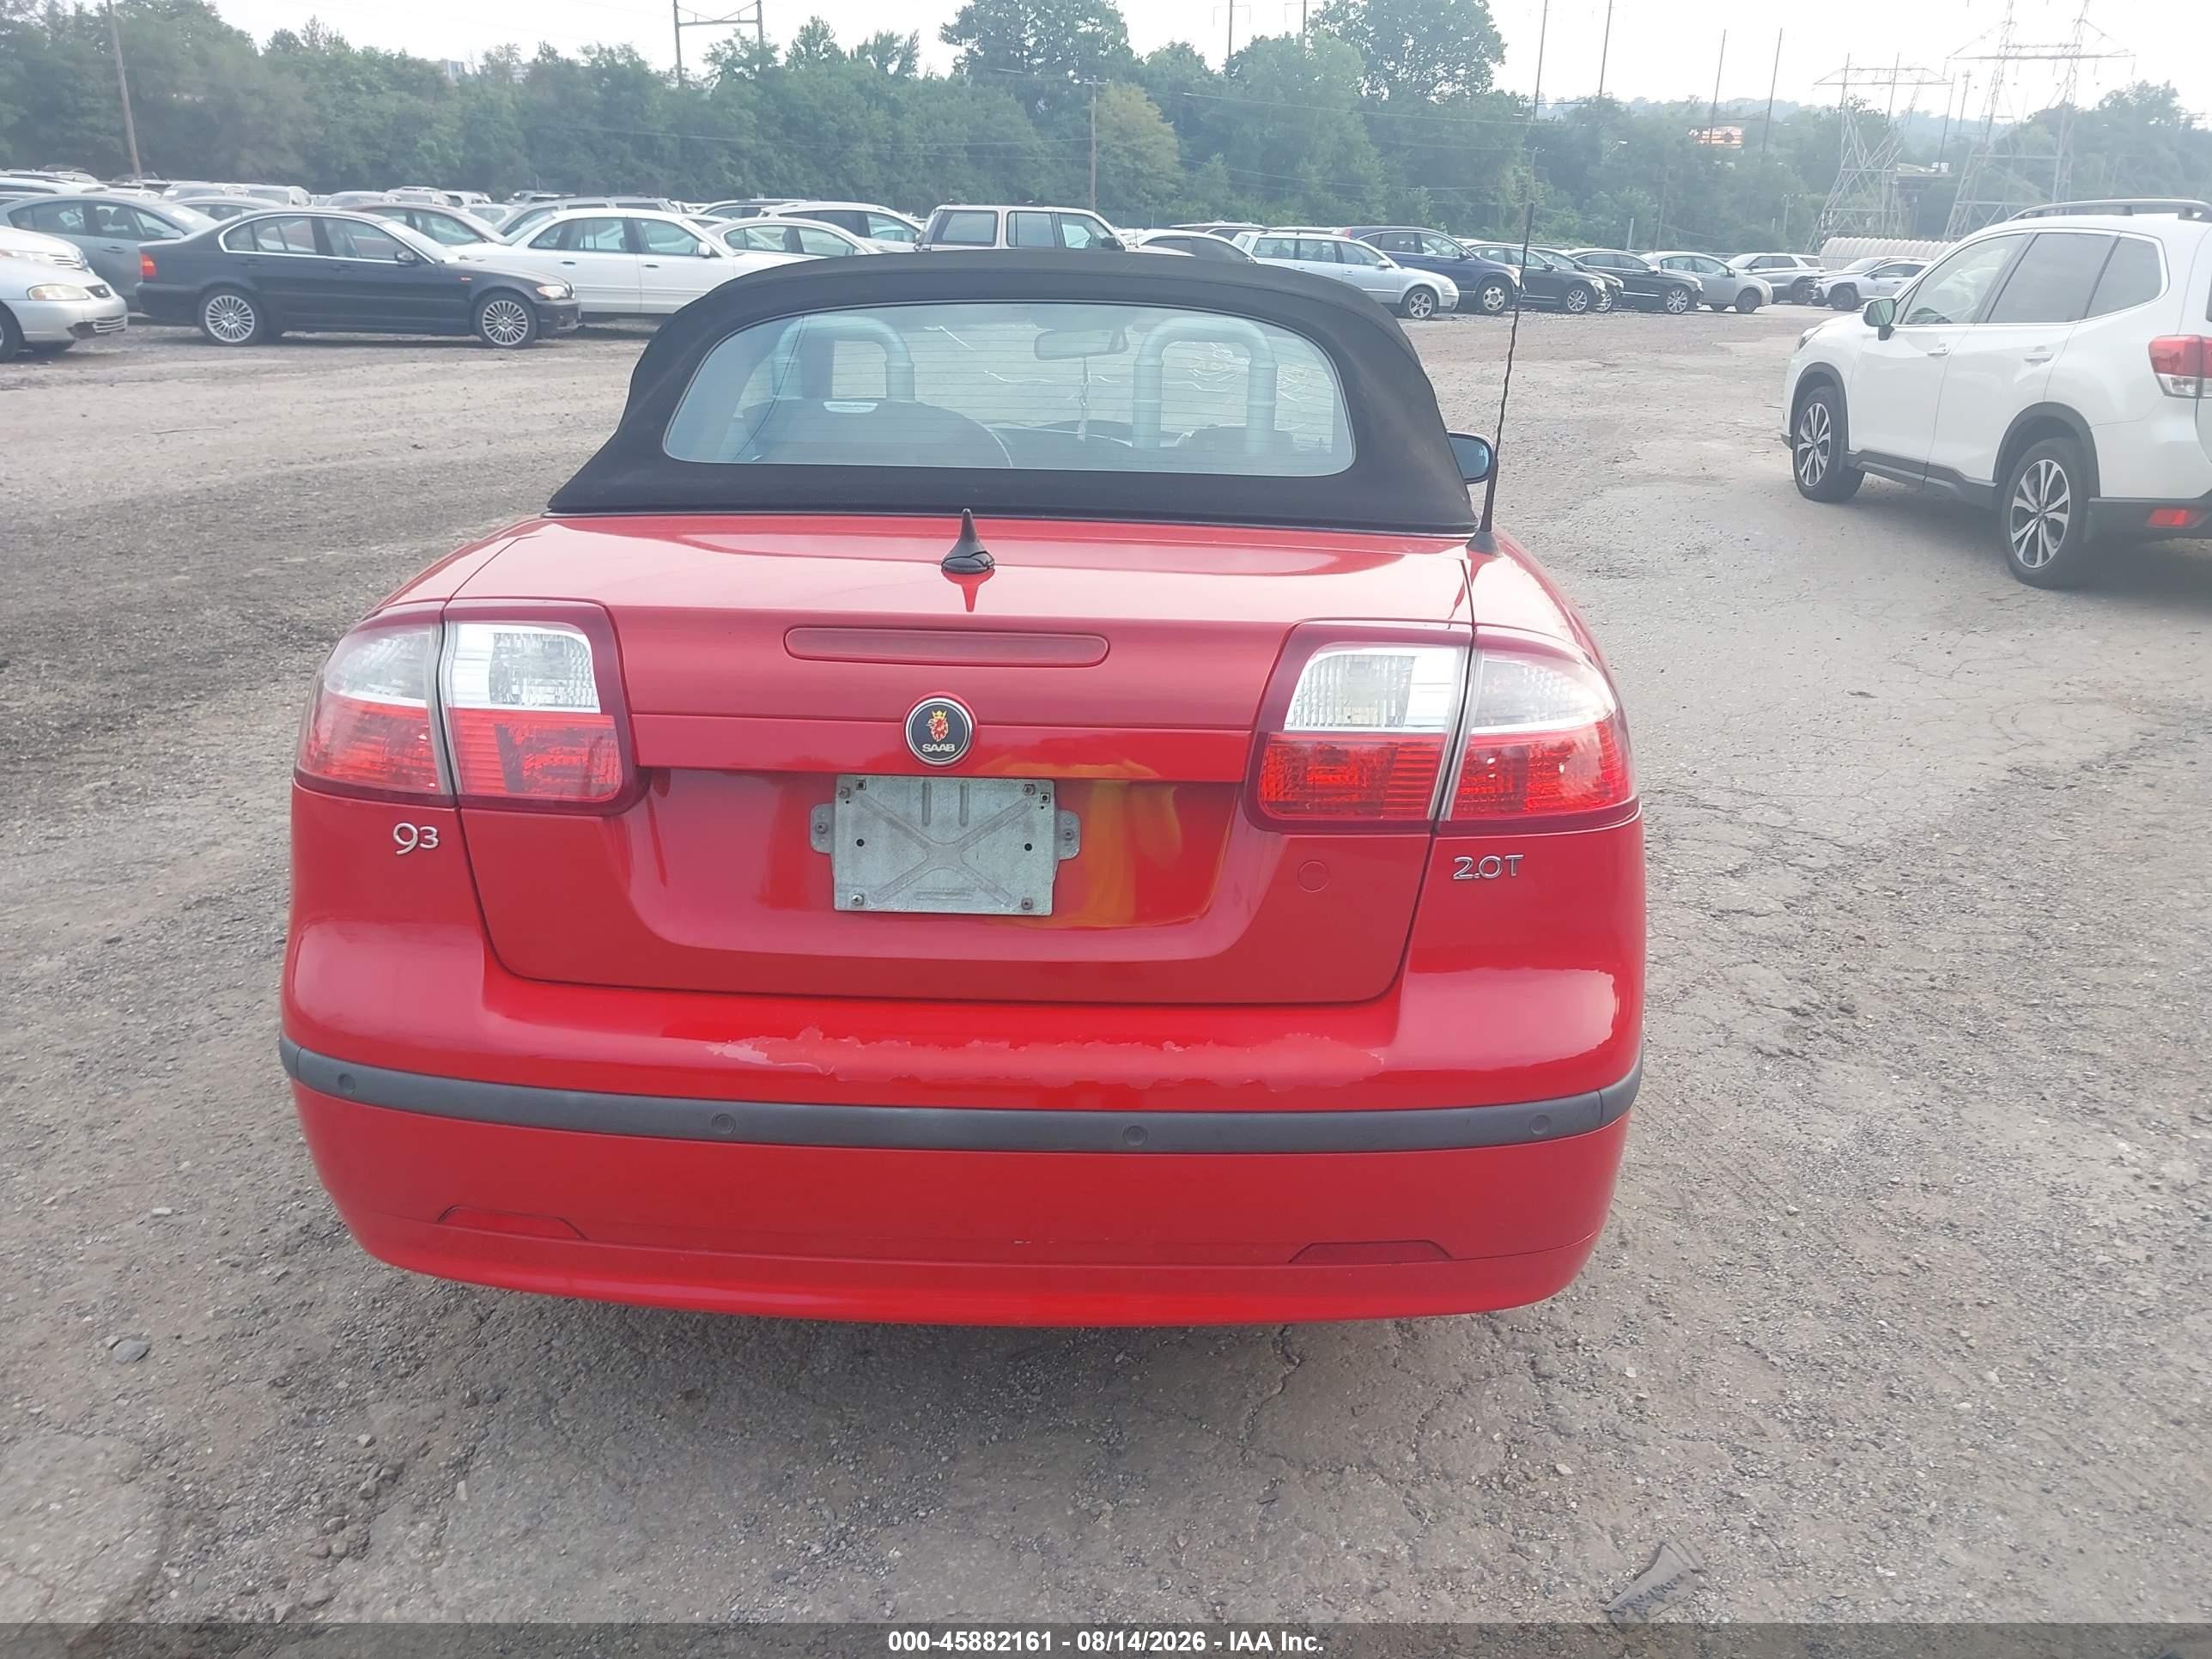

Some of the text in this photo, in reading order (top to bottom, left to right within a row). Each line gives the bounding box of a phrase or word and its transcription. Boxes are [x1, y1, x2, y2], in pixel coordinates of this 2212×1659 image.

[921, 744, 956, 752] SAAB
[393, 822, 439, 855] 93
[1452, 854, 1525, 880] 2.0T
